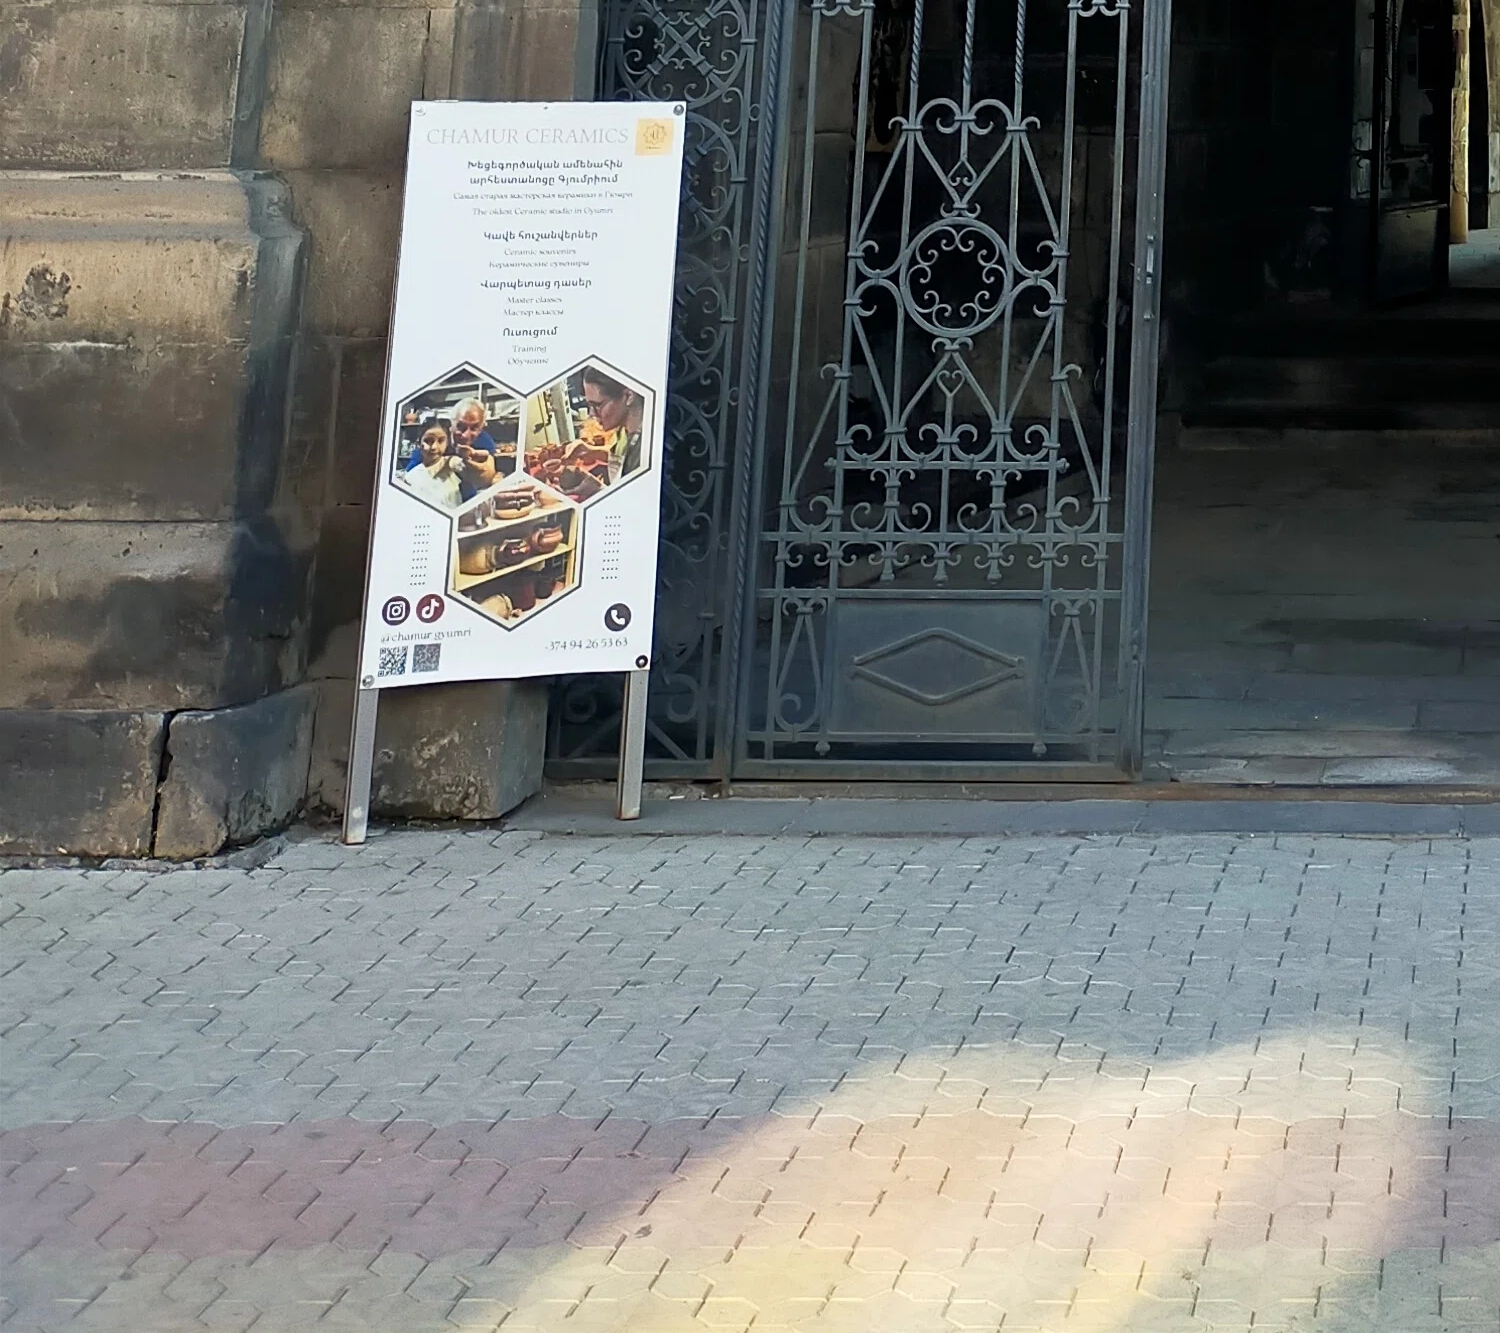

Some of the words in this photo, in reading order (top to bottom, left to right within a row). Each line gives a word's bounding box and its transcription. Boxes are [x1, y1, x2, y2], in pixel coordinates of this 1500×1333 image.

[427, 128, 520, 145] CHAMUR
[525, 127, 629, 144] CERAMICS
[483, 230, 516, 242] Կավե
[518, 229, 598, 242] հուշանվերներ
[502, 326, 558, 338] Ուսուցում
